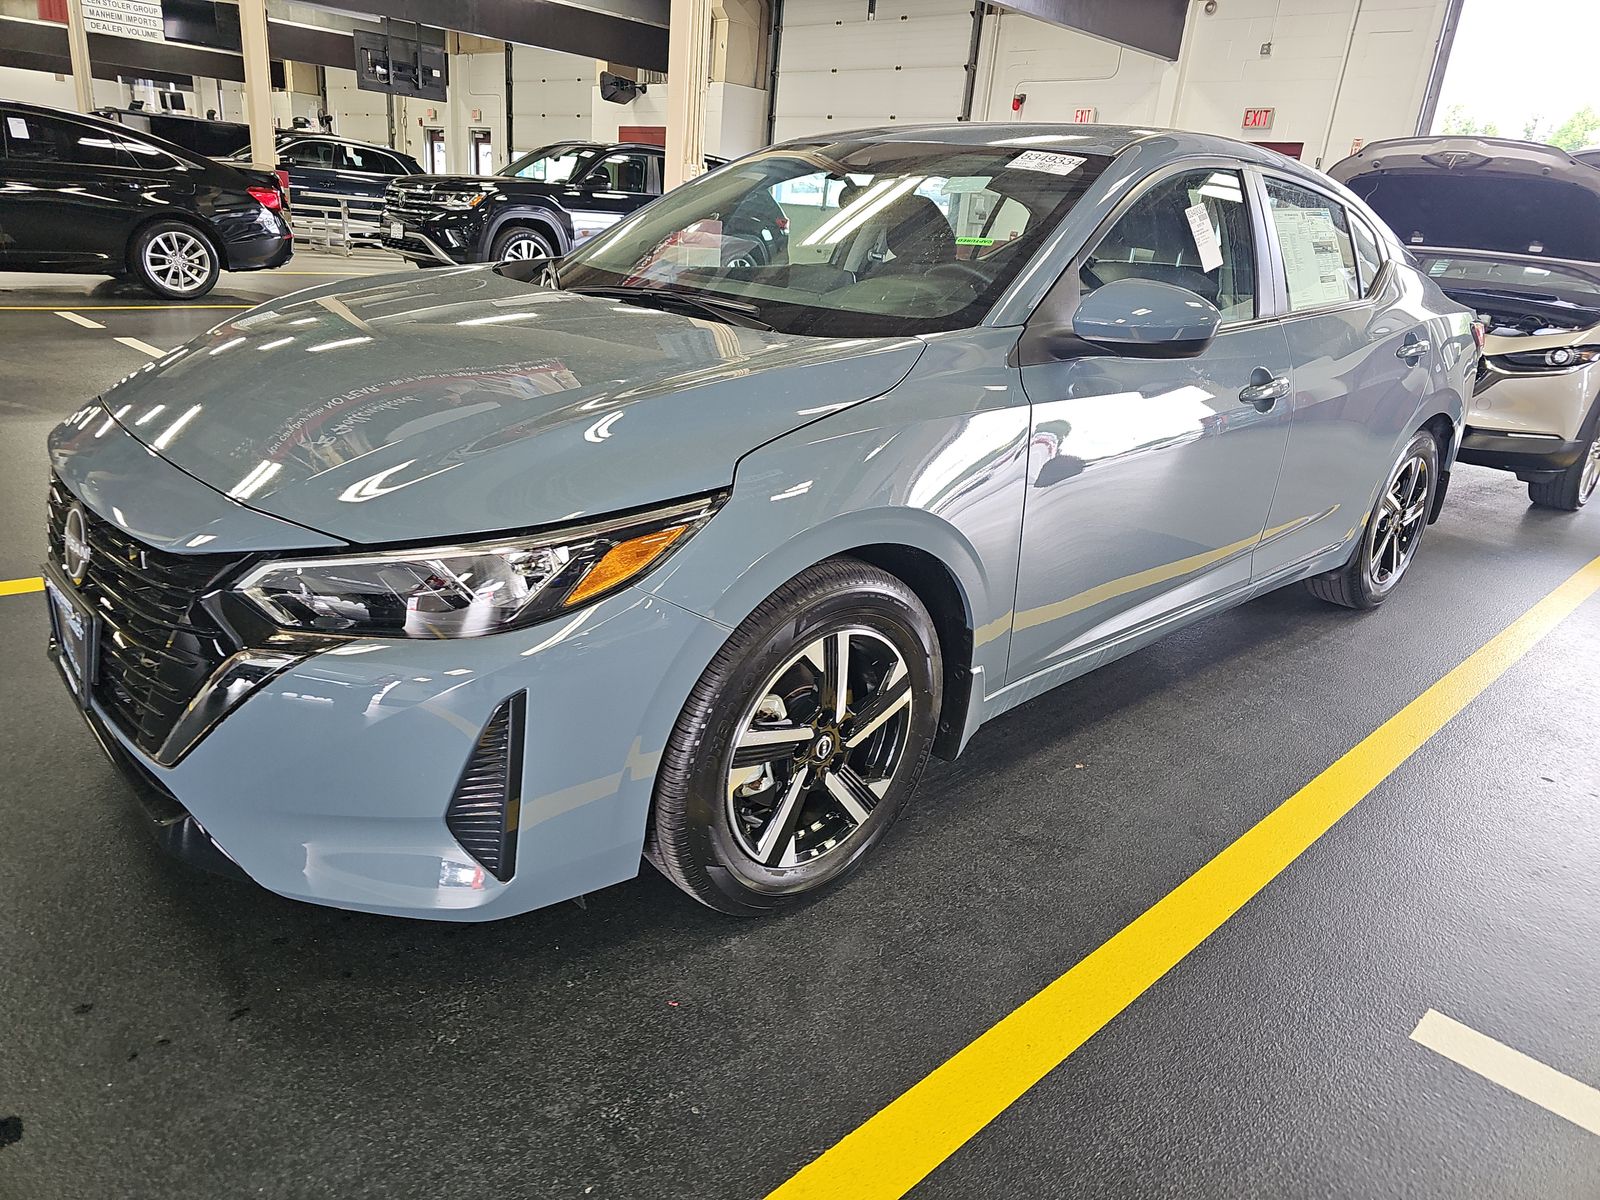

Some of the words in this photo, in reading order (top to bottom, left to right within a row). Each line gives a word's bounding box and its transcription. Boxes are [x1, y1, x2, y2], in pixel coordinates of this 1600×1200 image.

[102, 0, 132, 10] STOLER
[133, 5, 158, 14] GROUP
[89, 9, 122, 20] MANHEIM
[126, 14, 157, 27] IMPORTS
[90, 22, 123, 33] DEALER
[126, 28, 158, 39] VOLUME
[1075, 110, 1091, 123] EXIT
[1244, 110, 1270, 126] EXIT
